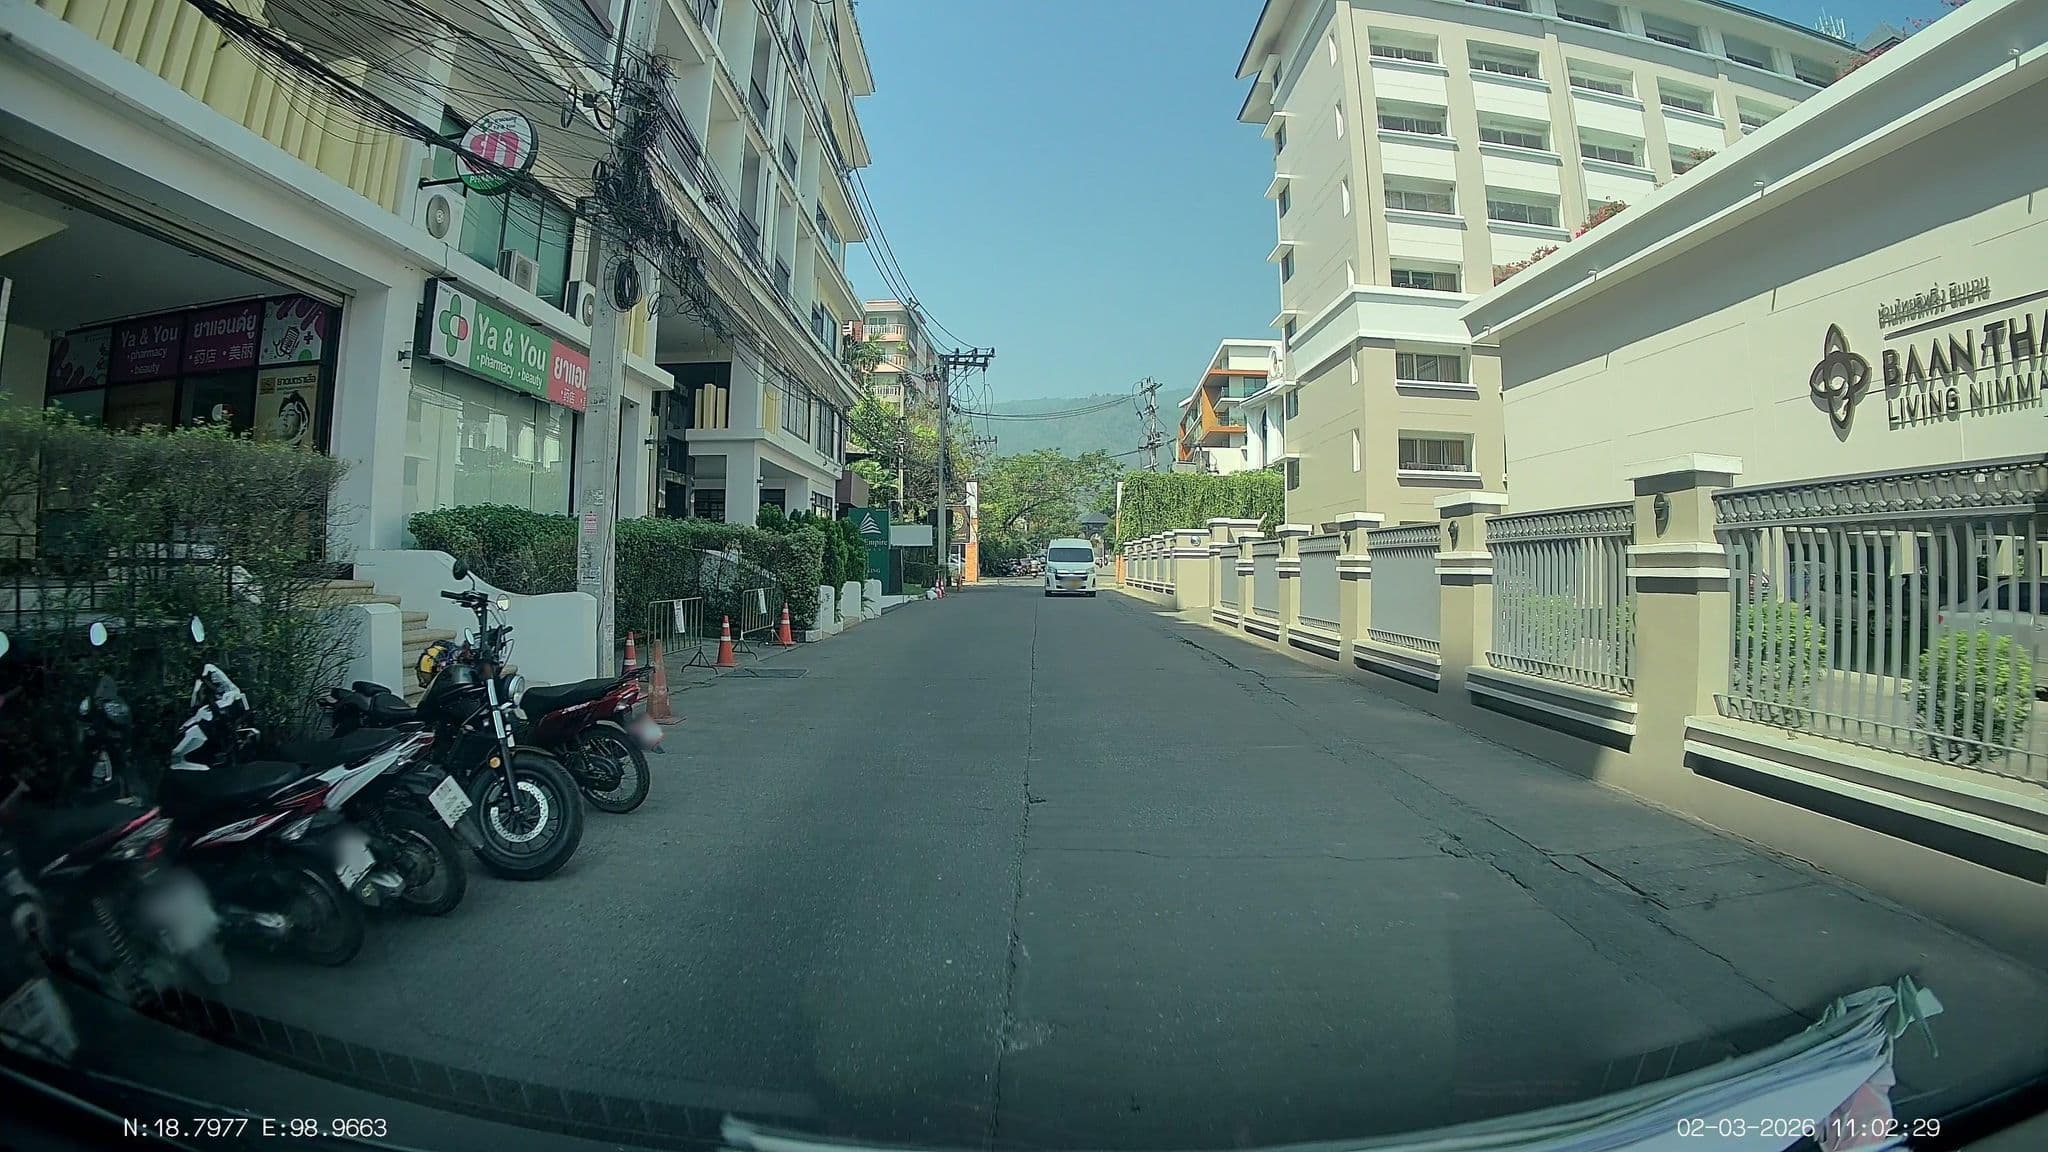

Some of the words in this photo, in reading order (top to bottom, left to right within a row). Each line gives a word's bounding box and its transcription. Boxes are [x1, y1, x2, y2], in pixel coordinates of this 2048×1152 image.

[121, 331, 136, 349] Ya
[139, 328, 149, 345] &
[153, 325, 178, 344] You
[193, 309, 257, 340] ยาแอนด์ยู
[130, 347, 168, 362] pharmacy
[478, 313, 498, 351] Ya
[502, 327, 514, 357] &
[520, 333, 547, 372] You
[134, 362, 161, 375] beauty
[480, 353, 514, 379] pharmacy
[1883, 329, 1977, 387] BAAN
[521, 368, 543, 390] beauty
[1888, 388, 1960, 422] LIVING
